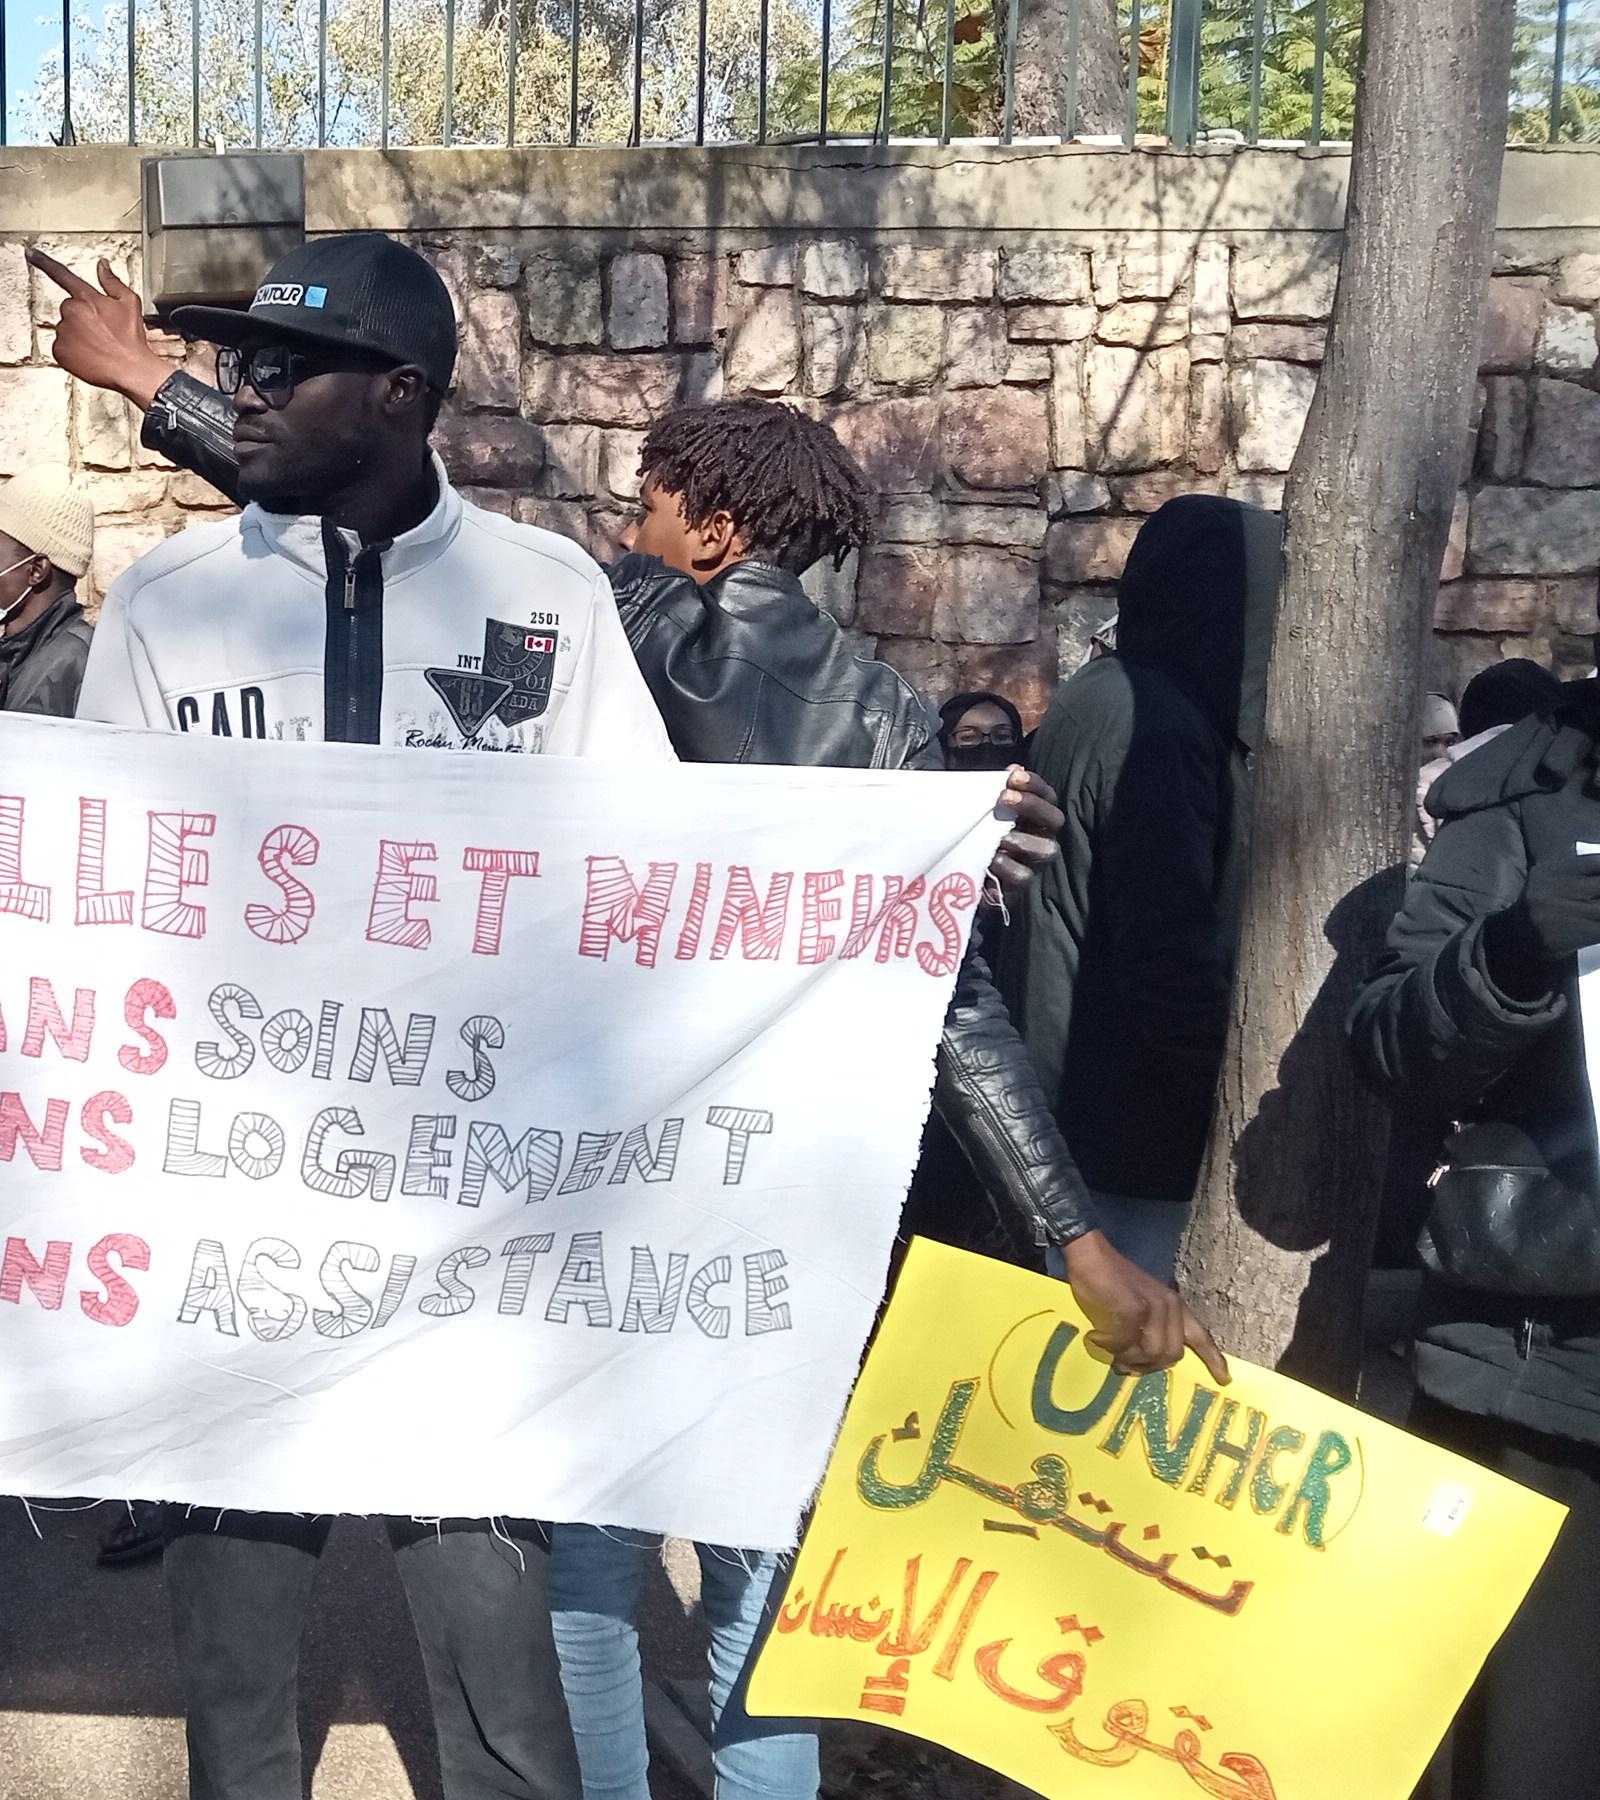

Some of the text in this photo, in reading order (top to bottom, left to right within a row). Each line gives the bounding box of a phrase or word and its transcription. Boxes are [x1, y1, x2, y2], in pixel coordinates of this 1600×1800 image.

[457, 655, 481, 670] INT
[530, 612, 559, 625] 2501
[366, 840, 541, 955] ET
[196, 983, 505, 1102] SOINS
[163, 1097, 773, 1207] LOGEMENT
[177, 1231, 793, 1341] ASSISTANCE
